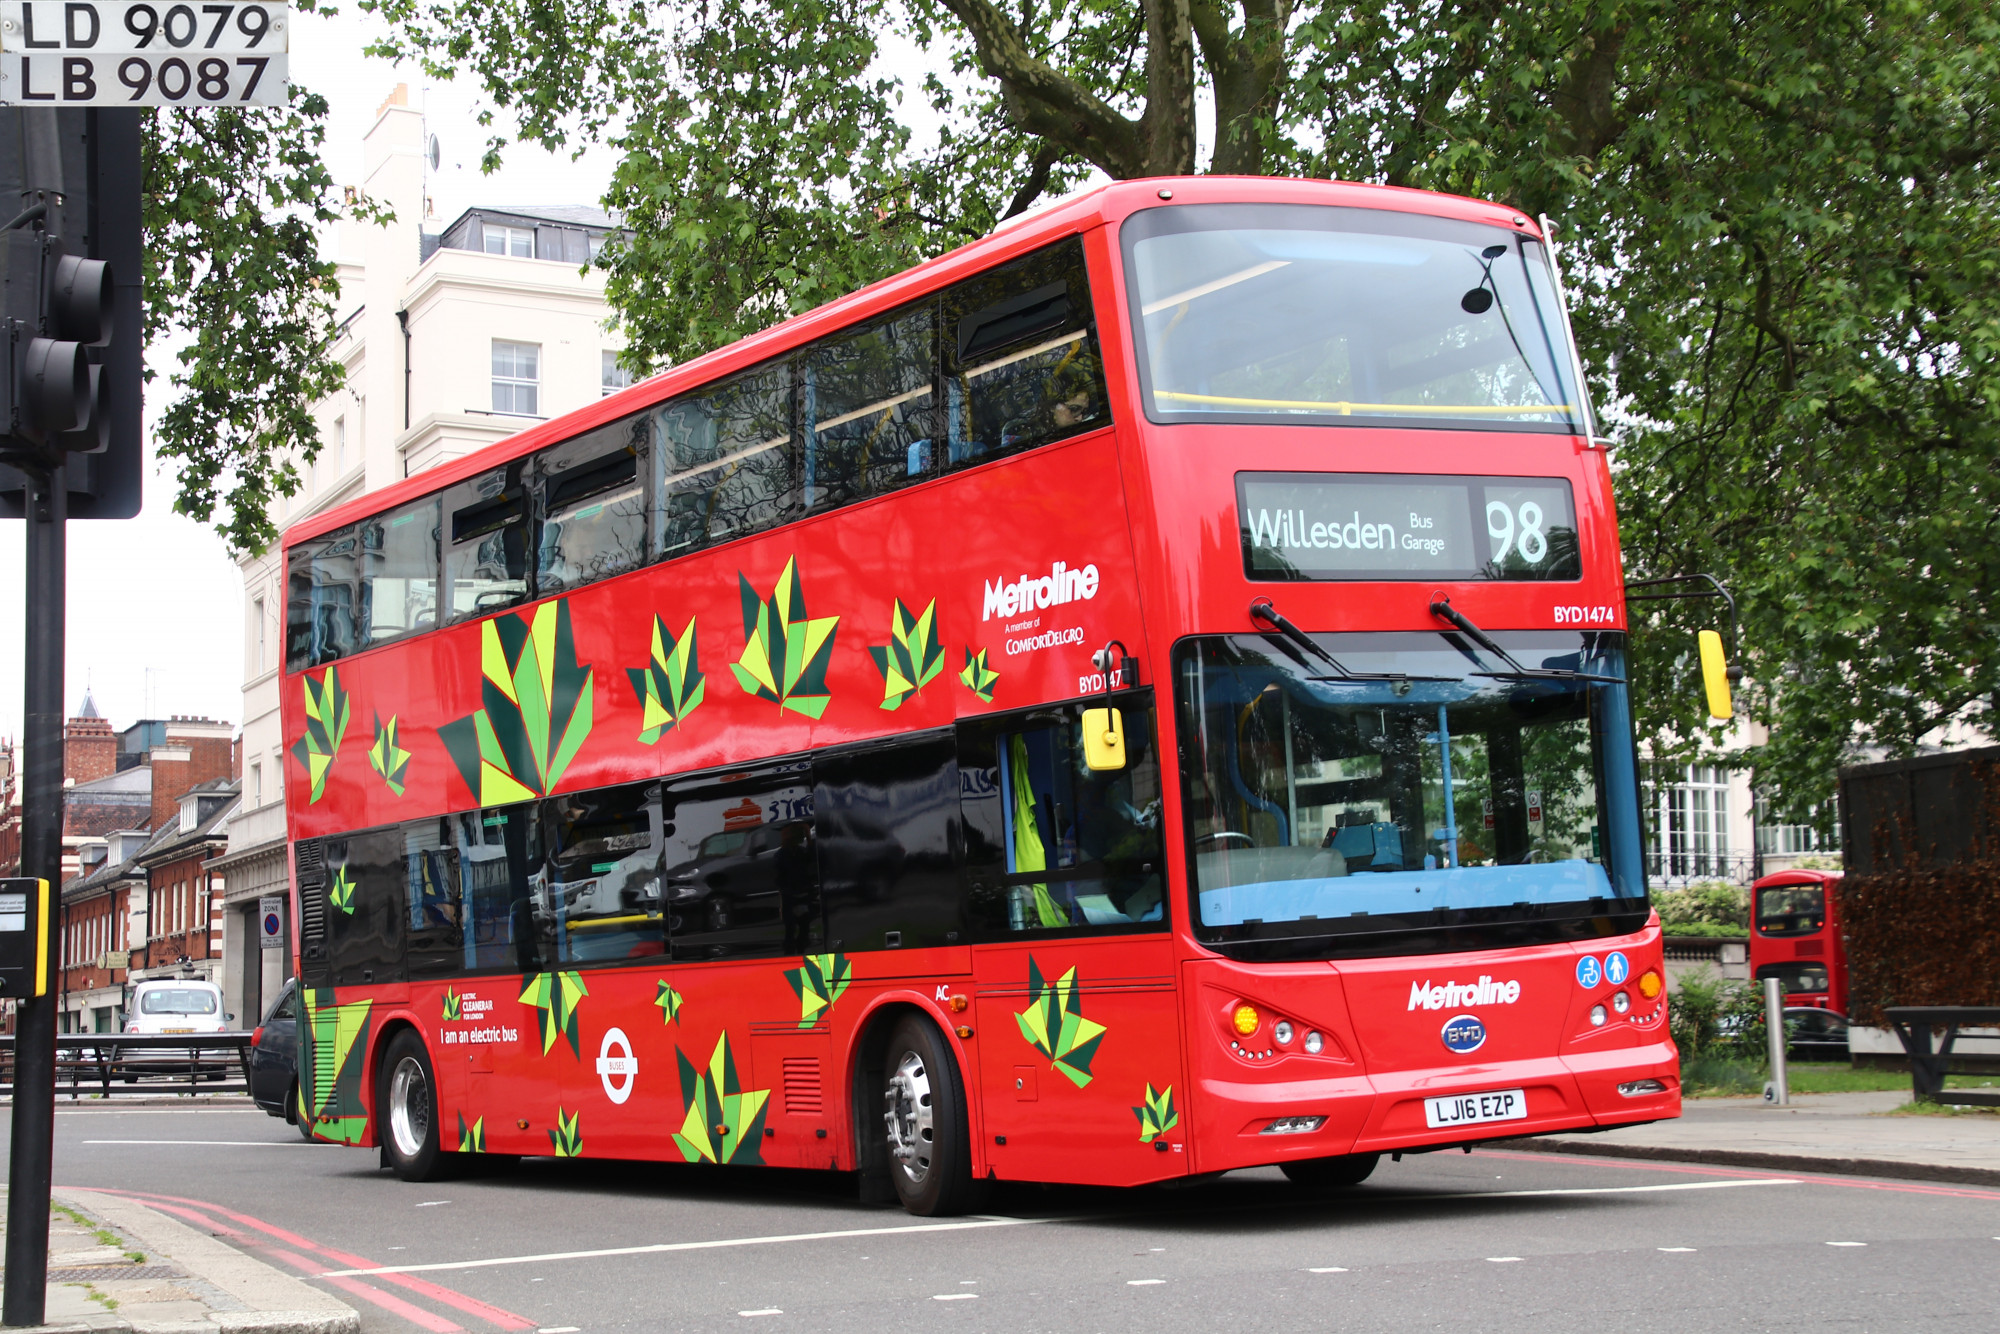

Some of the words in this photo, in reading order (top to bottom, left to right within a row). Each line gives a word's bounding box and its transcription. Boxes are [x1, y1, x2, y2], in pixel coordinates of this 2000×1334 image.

[1247, 508, 1396, 550] Willesden
[1409, 512, 1433, 529] Bus
[1486, 500, 1548, 563] 98
[1401, 533, 1445, 556] Garage
[982, 561, 1099, 622] Metroline
[1004, 624, 1010, 634] A
[1010, 620, 1033, 632] member
[1034, 617, 1040, 628] of
[1553, 606, 1614, 624] BYD1474
[1079, 669, 1123, 694] BYD147
[935, 984, 950, 1001] AC
[1407, 975, 1521, 1011] Metroline
[440, 1027, 444, 1044] I
[445, 1031, 457, 1044] am
[459, 1030, 469, 1044] an
[470, 1026, 501, 1043] electric
[502, 1025, 518, 1042] bus
[1447, 1025, 1482, 1043] BYD
[609, 1061, 625, 1071] BUSES
[1436, 1098, 1477, 1122] LJ16
[1481, 1094, 1514, 1118] EZP
